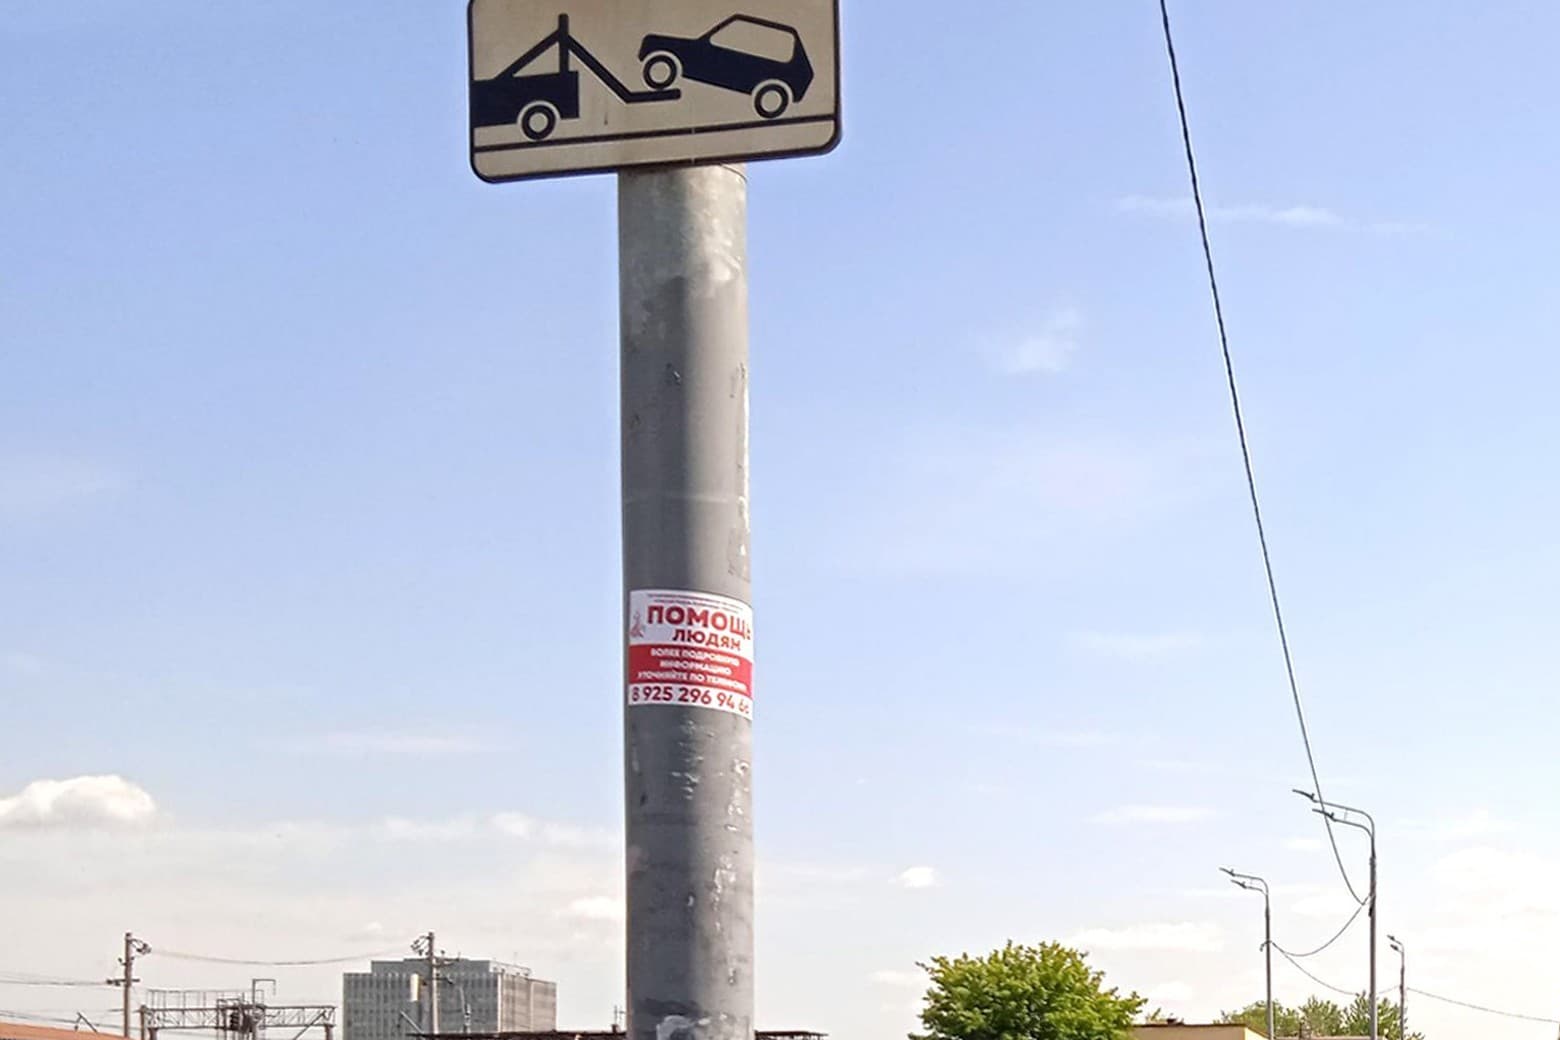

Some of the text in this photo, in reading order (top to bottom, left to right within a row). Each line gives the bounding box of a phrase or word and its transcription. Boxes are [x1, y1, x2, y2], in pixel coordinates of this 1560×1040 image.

[672, 629, 741, 651] ЛЮДЯМ
[632, 687, 640, 702] 8
[642, 686, 673, 701] 925
[679, 687, 712, 704] 296
